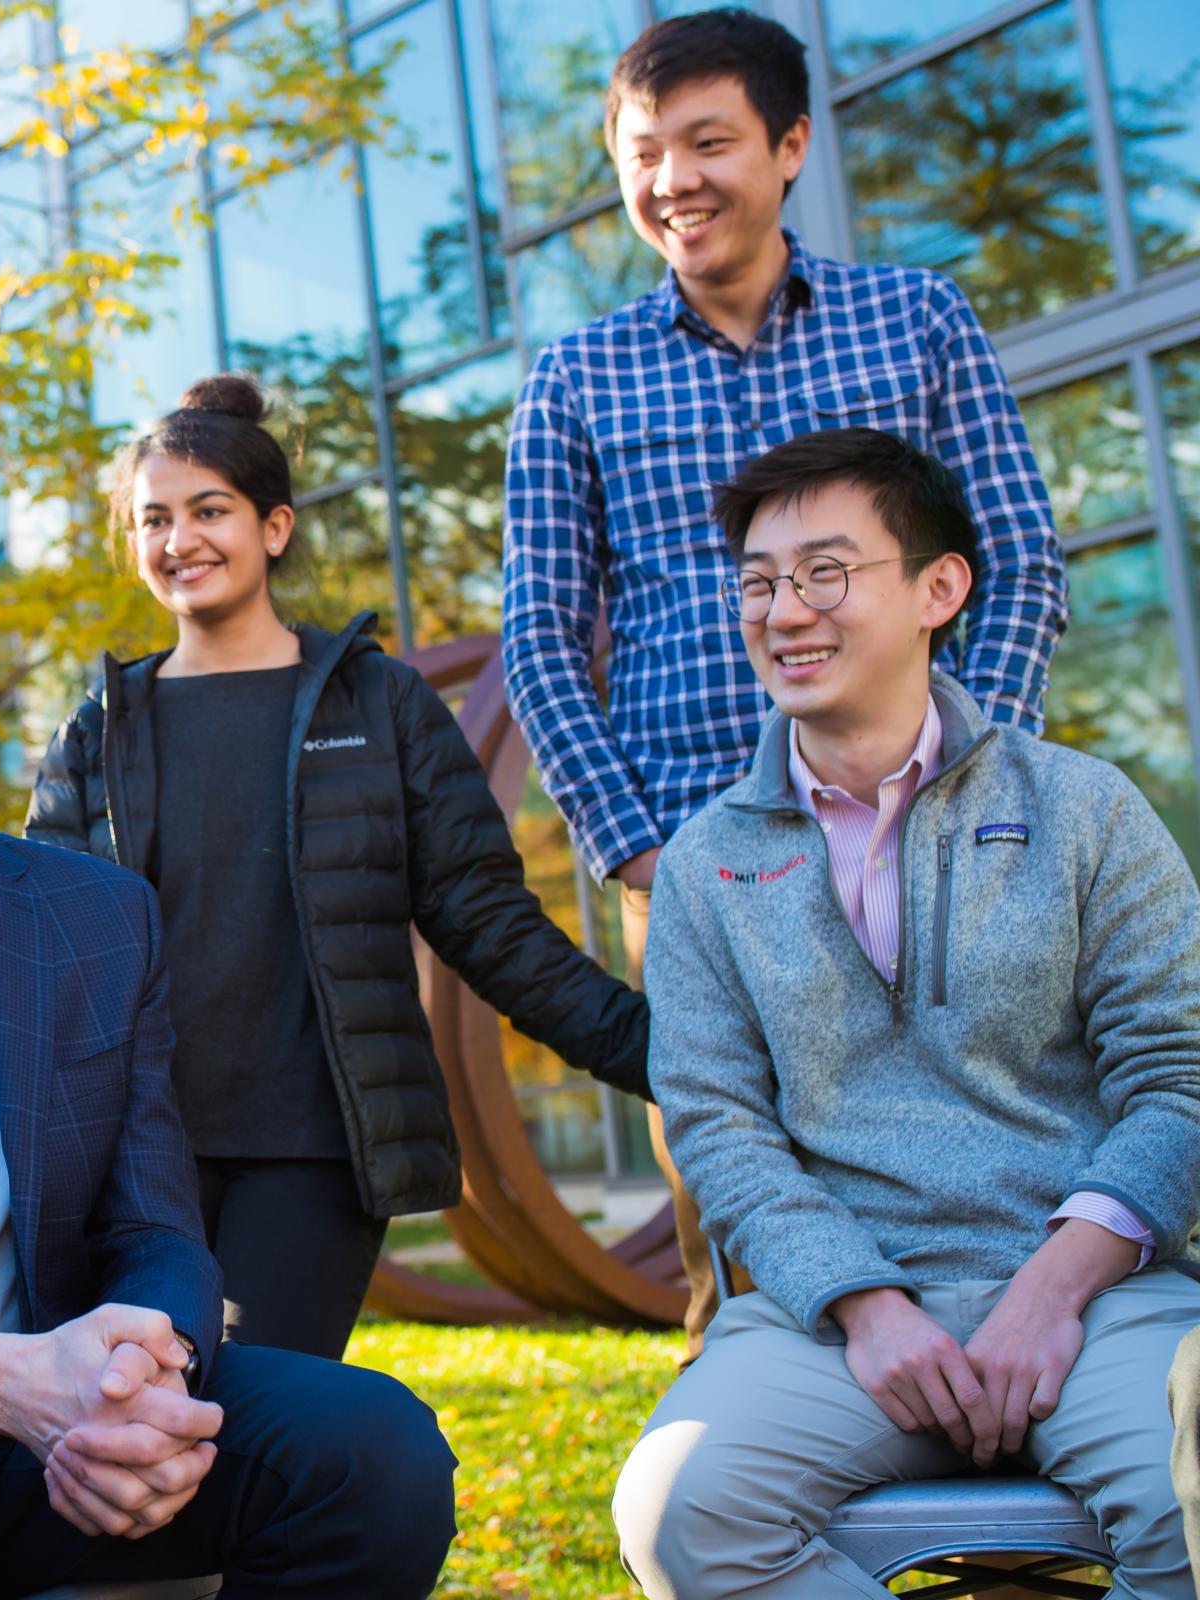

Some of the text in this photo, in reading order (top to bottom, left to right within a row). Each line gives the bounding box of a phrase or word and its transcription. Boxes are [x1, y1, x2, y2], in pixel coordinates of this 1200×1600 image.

[314, 735, 366, 750] Columbia
[981, 831, 1025, 842] patagonia
[734, 874, 756, 885] MIT
